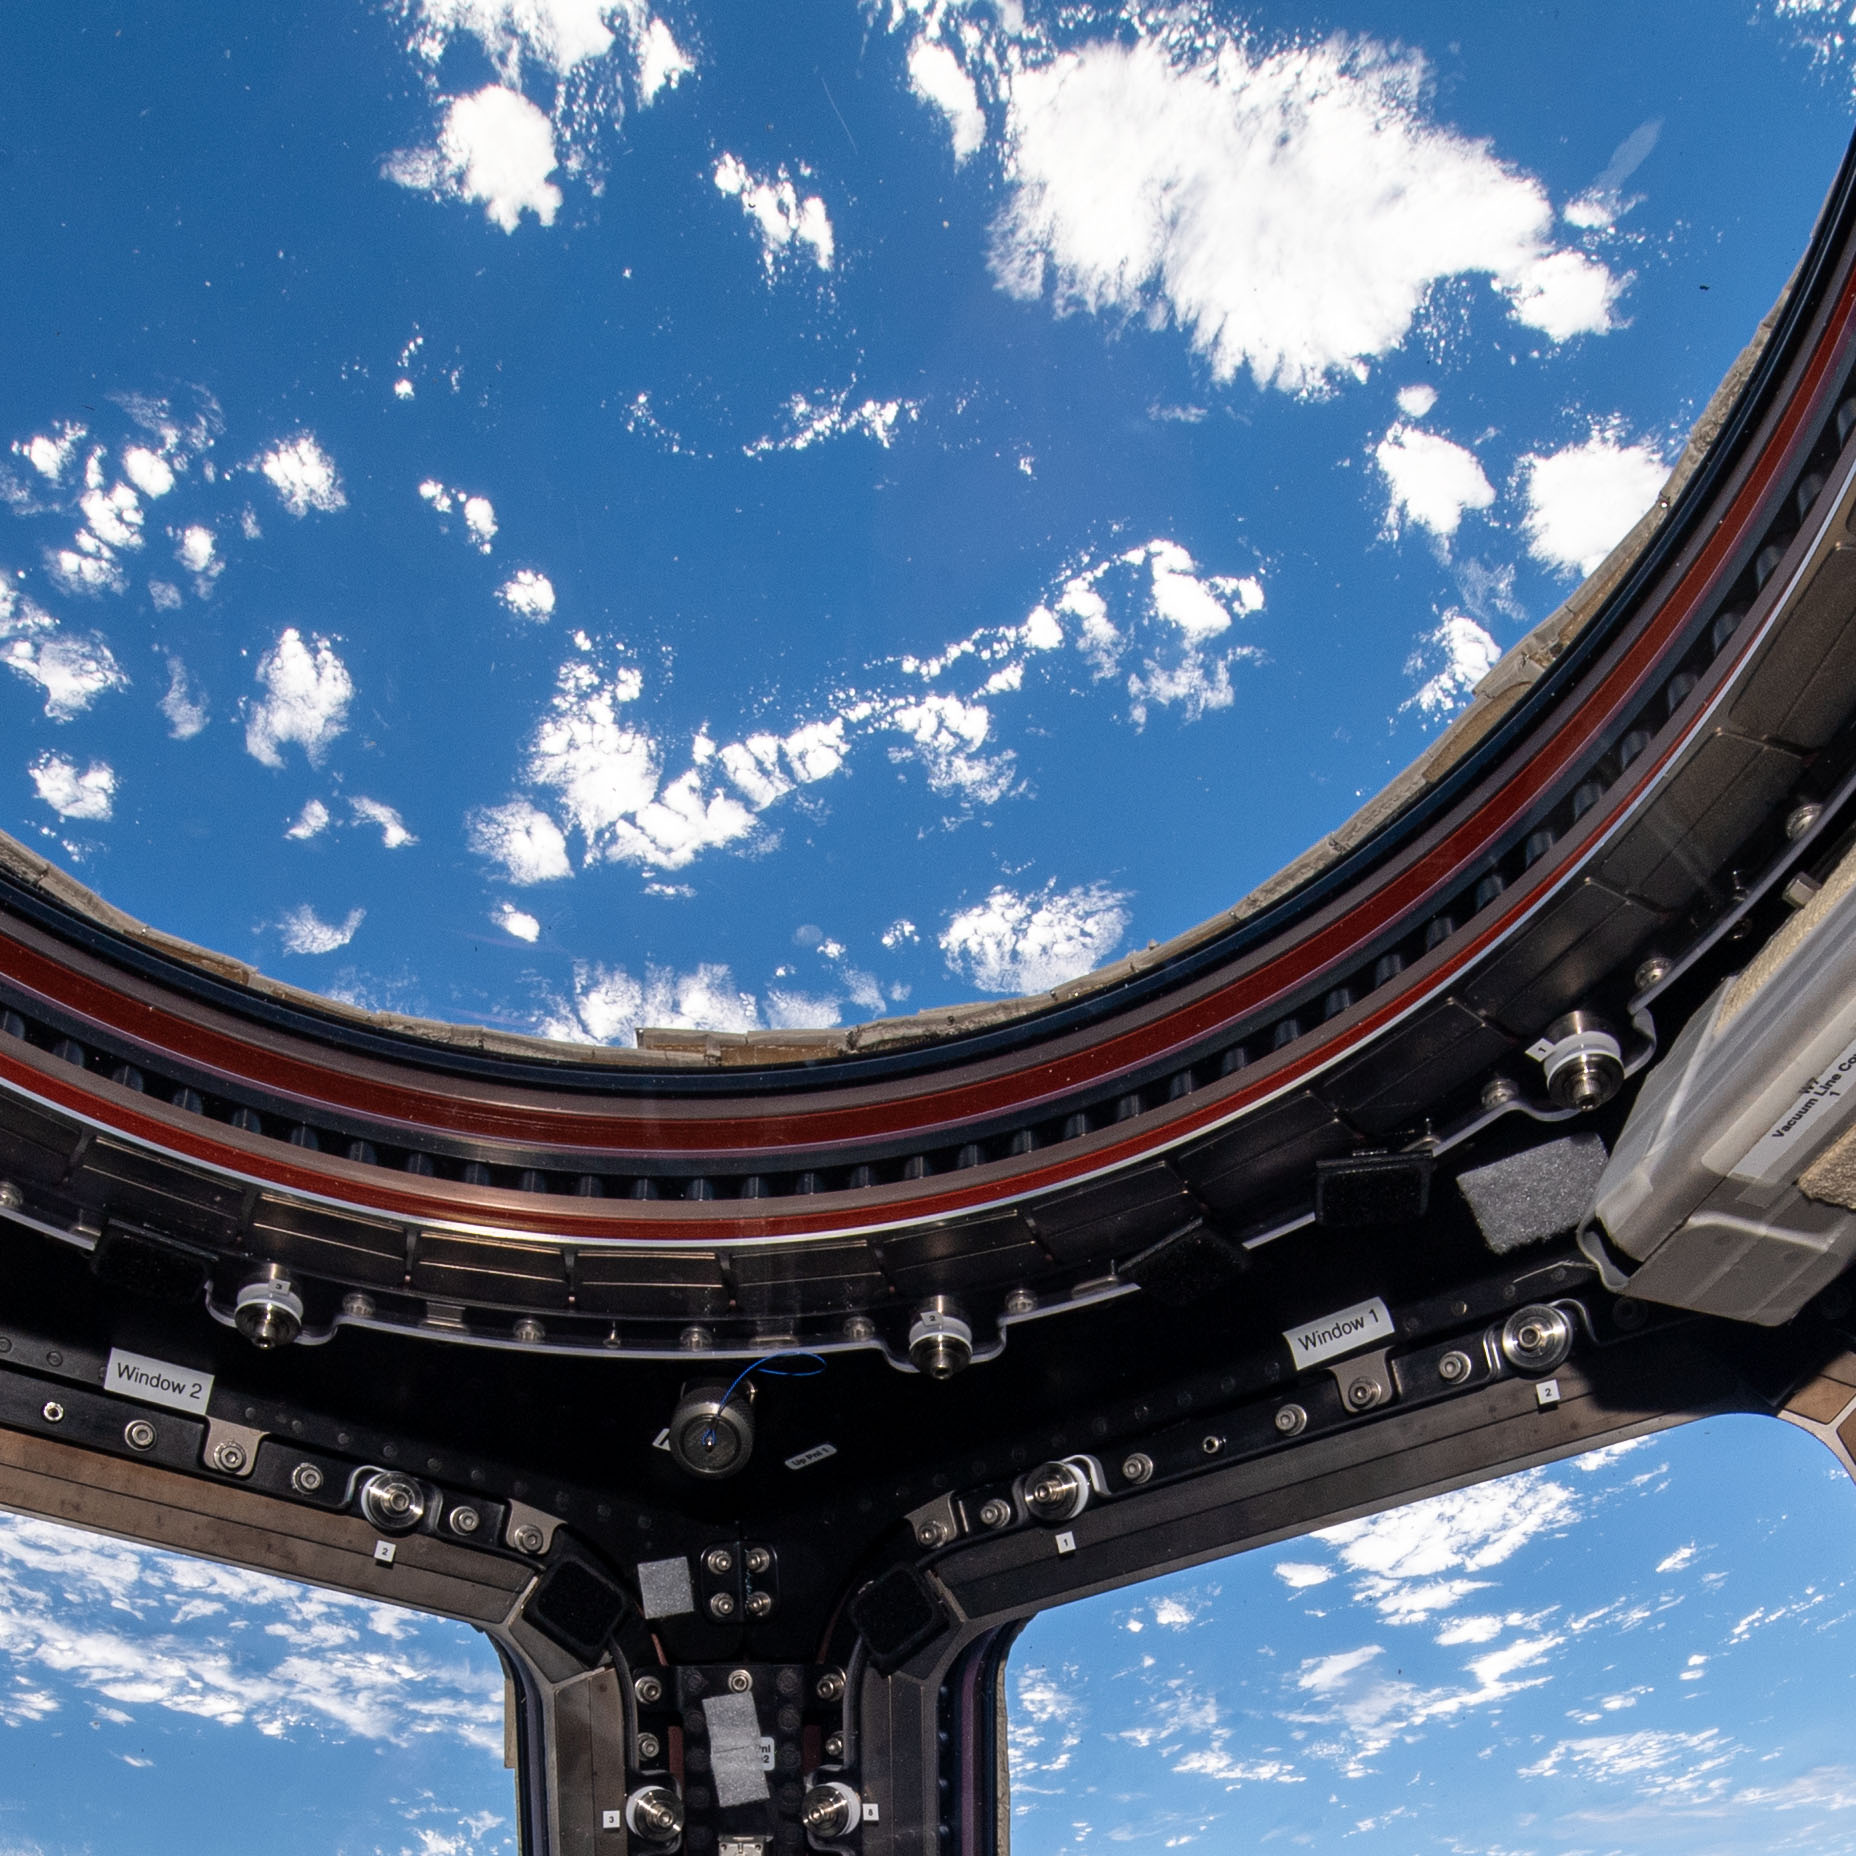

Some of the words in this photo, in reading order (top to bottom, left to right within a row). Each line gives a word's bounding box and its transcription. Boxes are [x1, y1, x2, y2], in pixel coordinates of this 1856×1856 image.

[1772, 1098, 1818, 1138] Vacuum
[1814, 1074, 1842, 1096] Line
[1297, 1320, 1366, 1352] Window
[1369, 1308, 1380, 1324] 1
[117, 1362, 186, 1394] Window
[190, 1383, 202, 1400] 2
